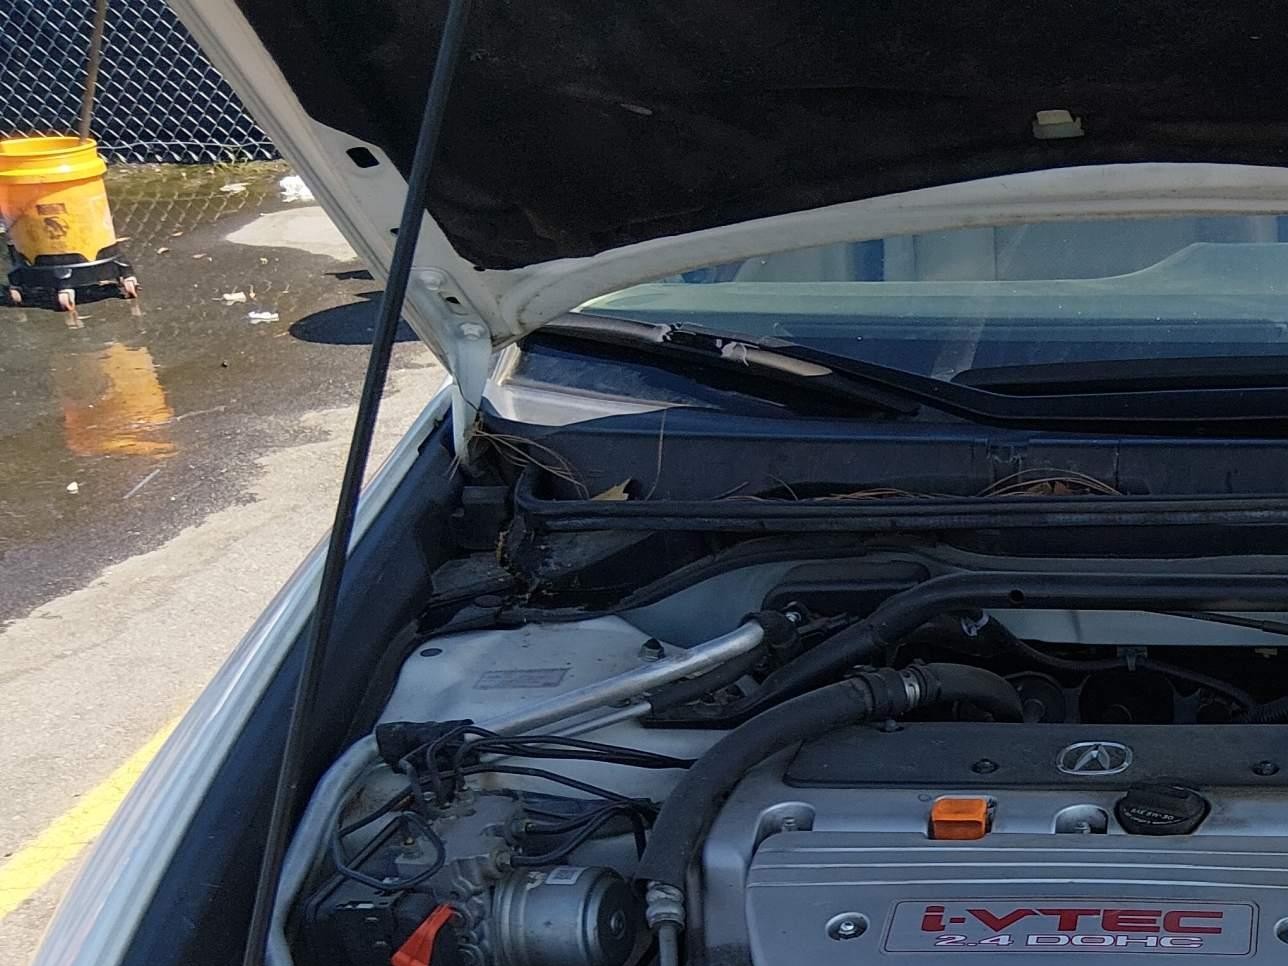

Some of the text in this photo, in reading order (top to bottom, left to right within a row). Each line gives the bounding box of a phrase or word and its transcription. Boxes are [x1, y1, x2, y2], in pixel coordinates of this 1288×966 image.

[920, 905, 1224, 935] i-VTEC
[934, 934, 1203, 949] 2.4 DOHC
